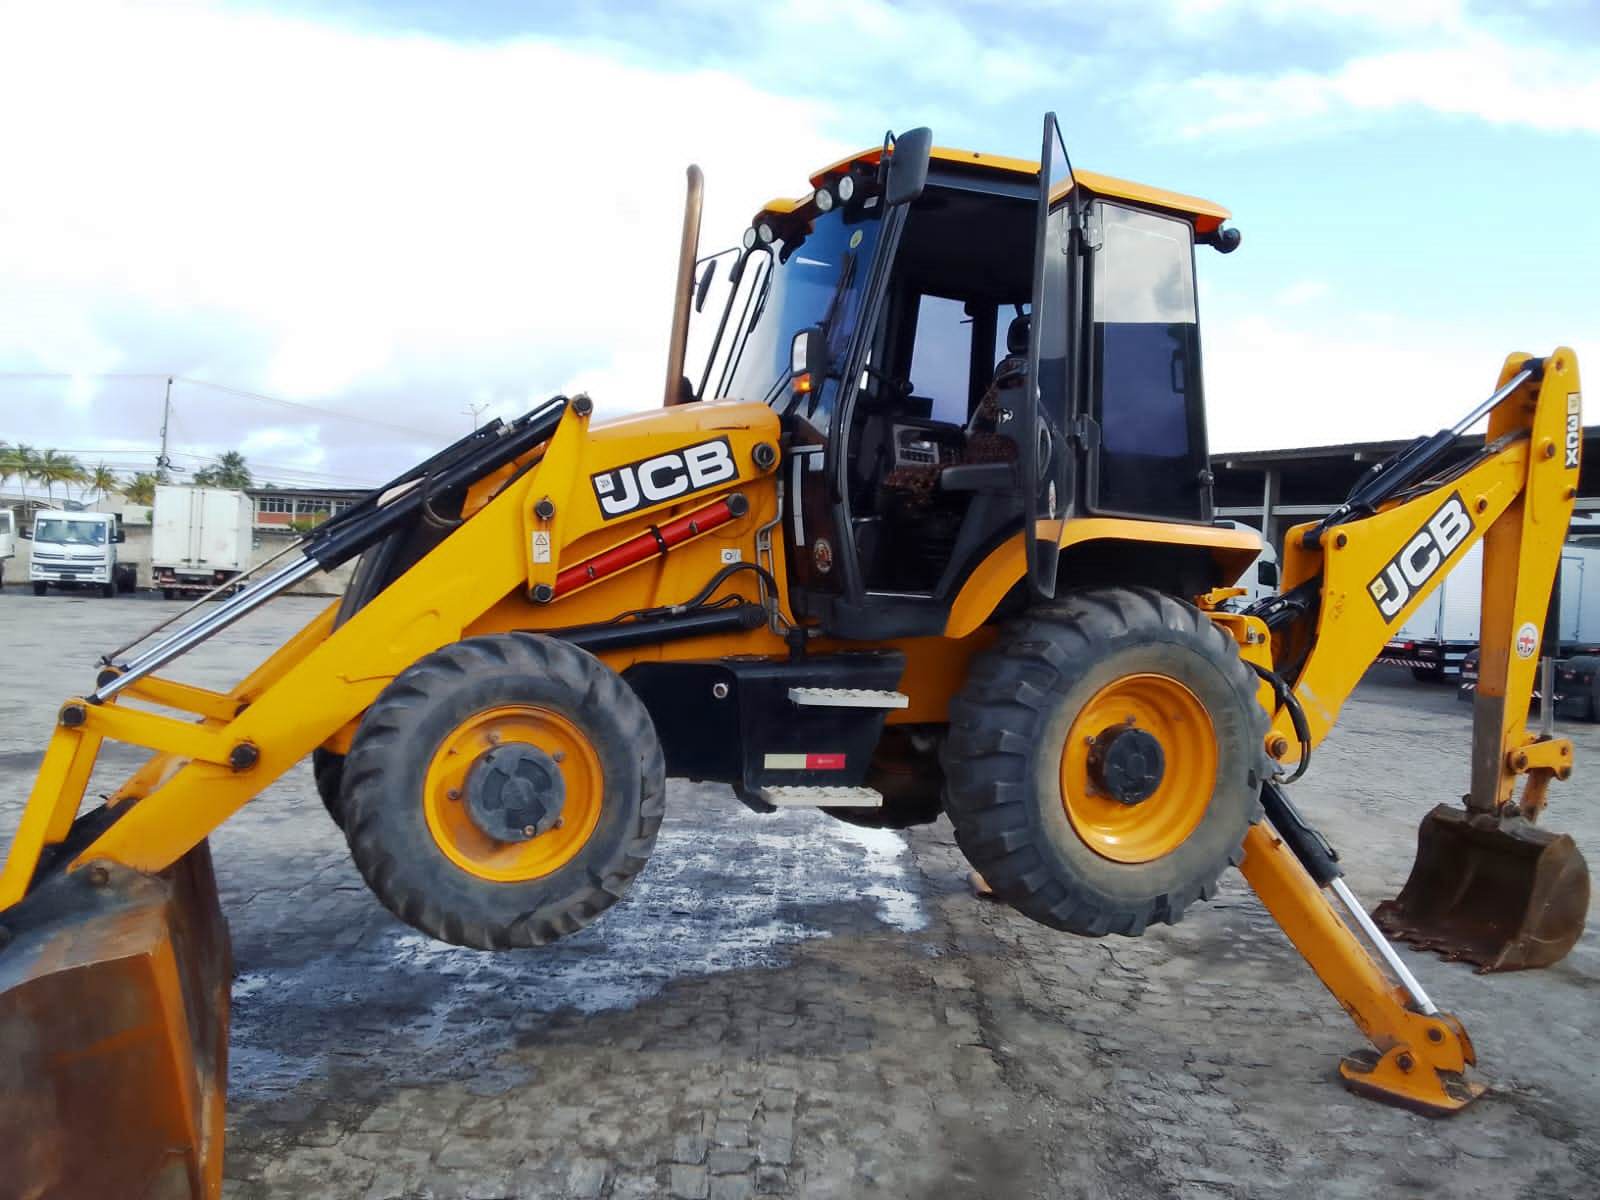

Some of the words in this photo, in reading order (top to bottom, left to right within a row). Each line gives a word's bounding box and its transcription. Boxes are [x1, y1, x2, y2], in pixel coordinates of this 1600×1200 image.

[594, 440, 735, 514] JCB
[1566, 414, 1579, 466] 3CX
[1370, 499, 1471, 616] JCB
